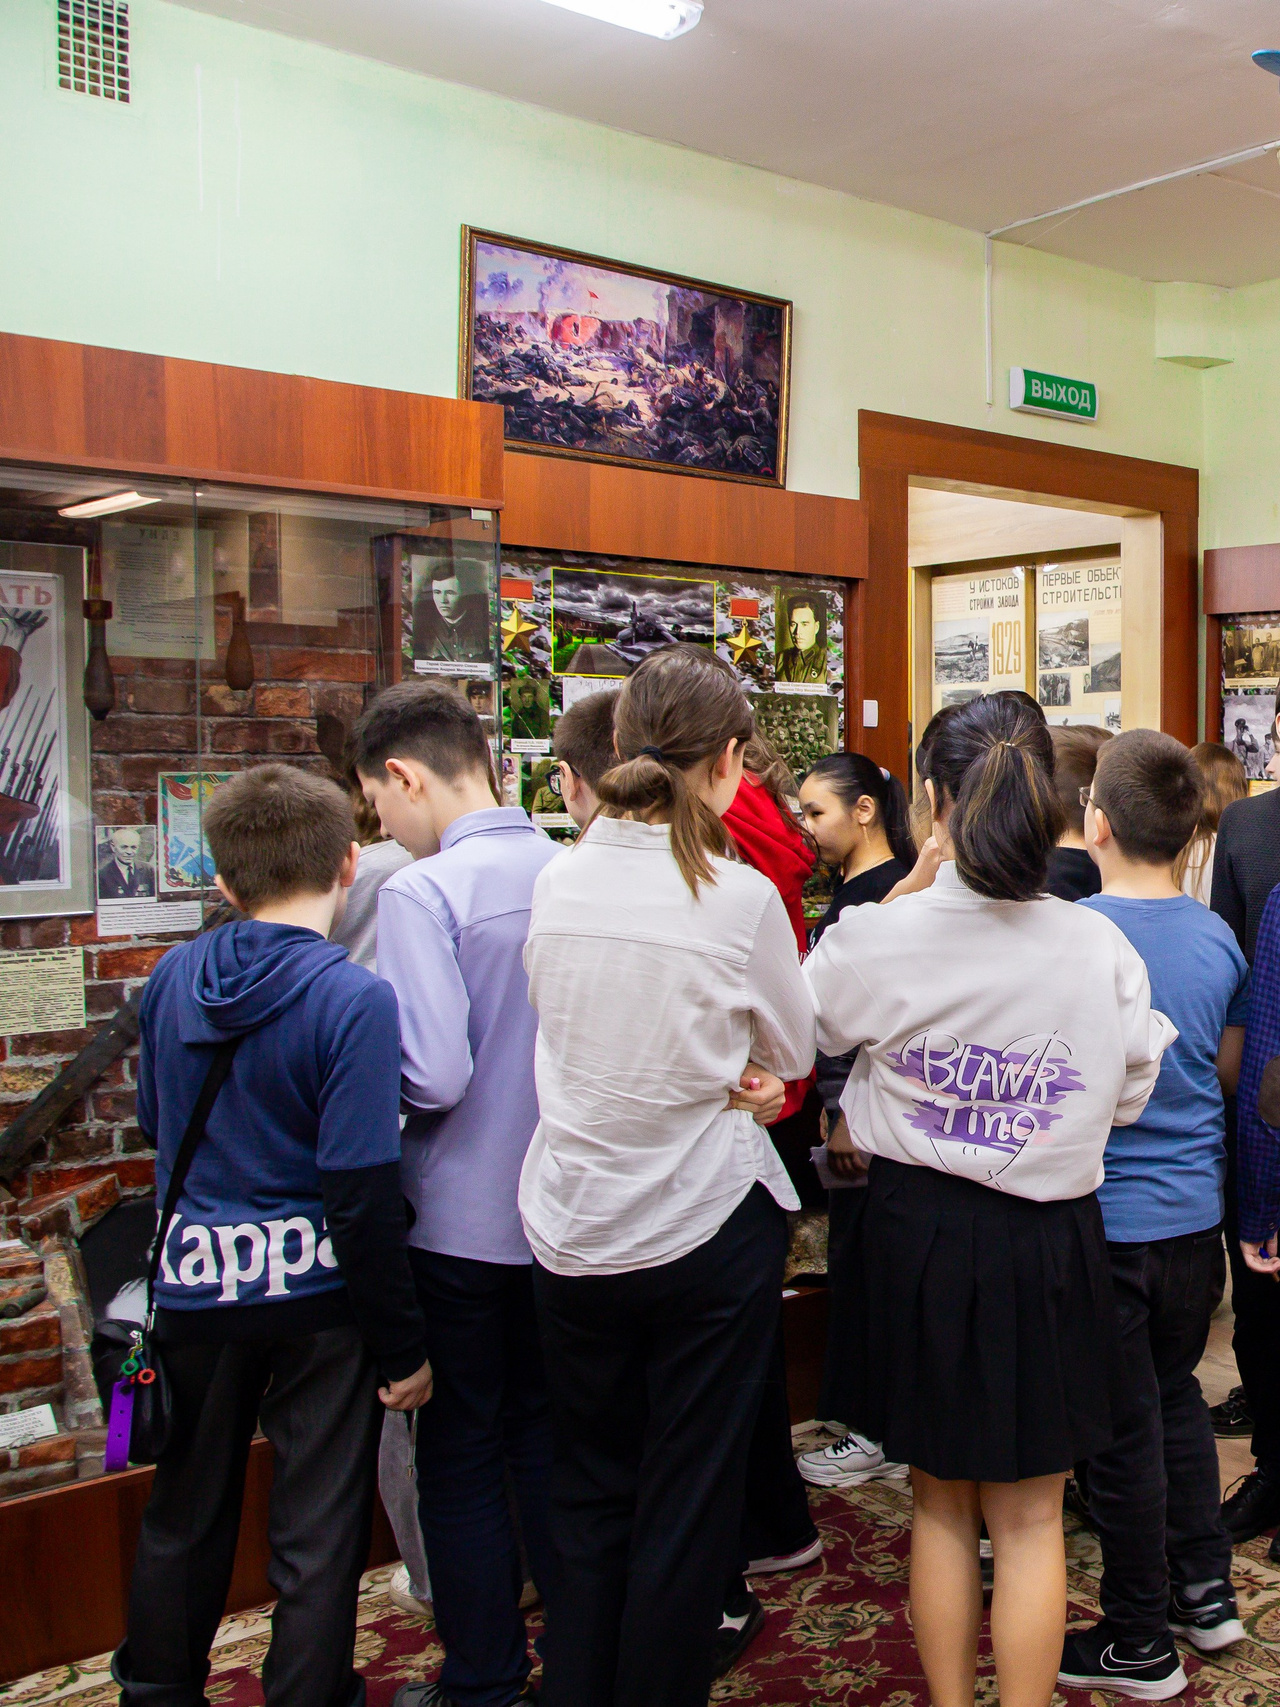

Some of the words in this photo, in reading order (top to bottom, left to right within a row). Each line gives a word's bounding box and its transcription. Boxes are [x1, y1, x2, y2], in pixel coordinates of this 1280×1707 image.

[1031, 379, 1091, 412] ВЫХОД
[969, 582, 975, 594] У
[979, 577, 1020, 592] ИСТОКОВ
[1042, 571, 1081, 587] ПЕРВЫЕ
[1087, 567, 1122, 582] ОБЪЕК
[969, 595, 995, 611] СТРОЙКИ
[997, 594, 1020, 608] ЗАВОДА
[1042, 585, 1122, 605] СТРОИТЕЛЬСТ
[992, 620, 1021, 676] 1929
